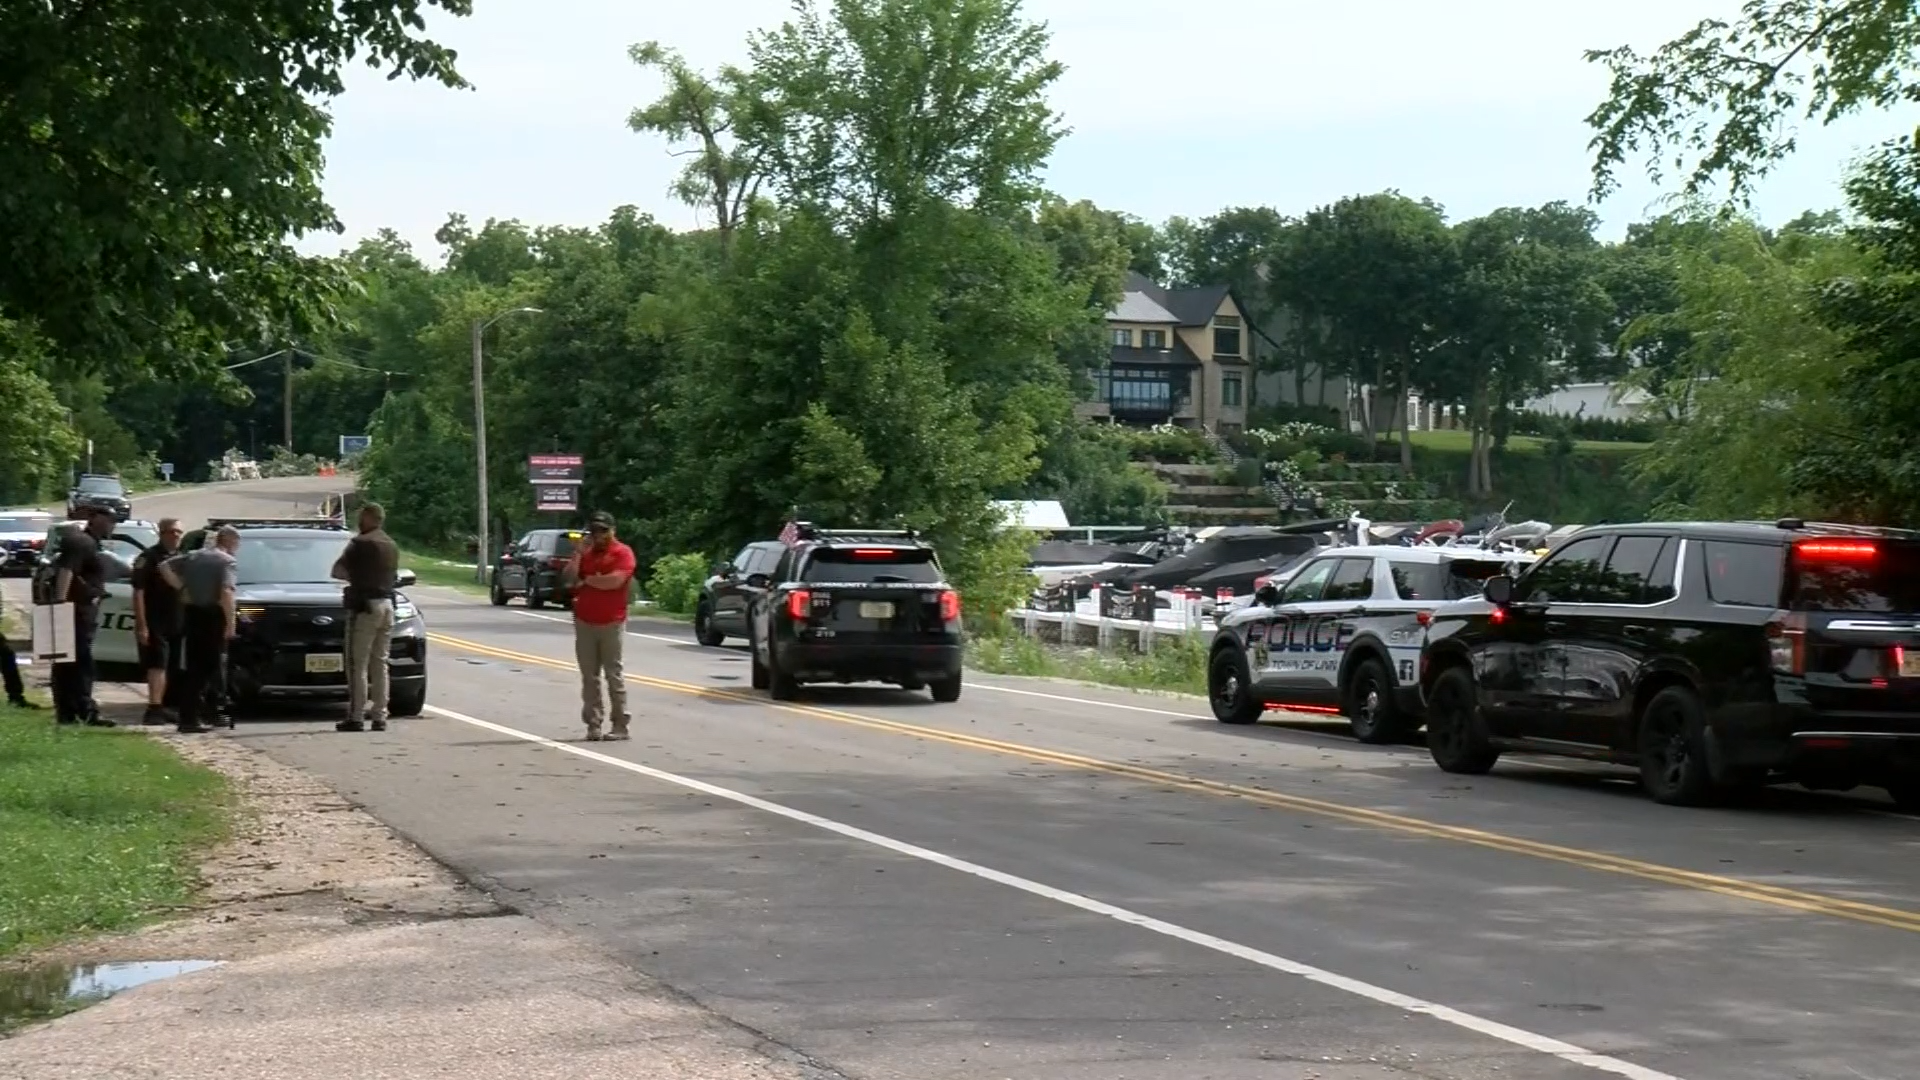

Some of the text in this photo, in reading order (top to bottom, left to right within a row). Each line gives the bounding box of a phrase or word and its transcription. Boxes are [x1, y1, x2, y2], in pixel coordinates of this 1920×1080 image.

[1245, 614, 1354, 651] POLICE
[1272, 659, 1300, 669] TOWN
[1301, 659, 1315, 670] OF
